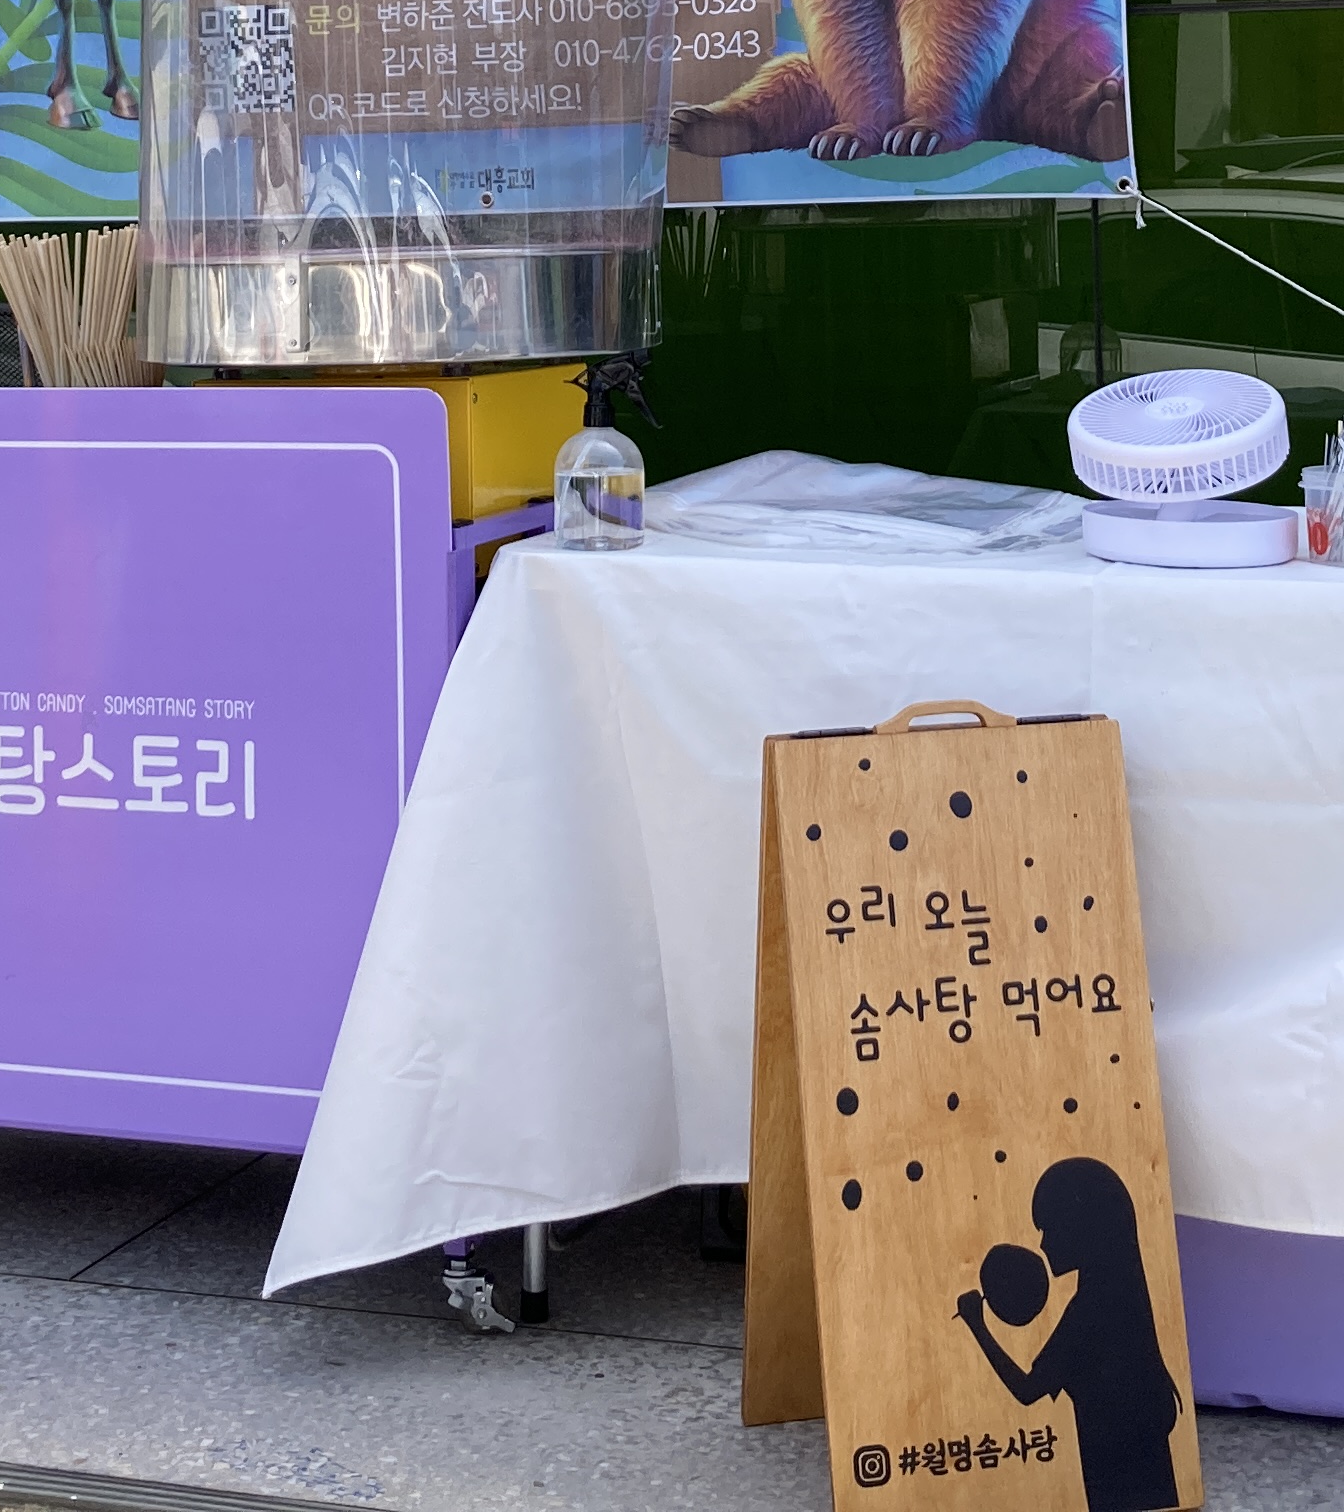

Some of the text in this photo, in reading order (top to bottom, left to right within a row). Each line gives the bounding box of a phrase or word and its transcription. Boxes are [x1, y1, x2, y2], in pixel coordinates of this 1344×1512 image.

[304, 3, 360, 36] 문의
[376, 0, 454, 33] 변하준
[381, 29, 761, 77] 김지현 부장 010-4762-0343
[308, 82, 583, 122] QR 코드로 신청하세요!
[478, 165, 534, 193] 대흥교회
[37, 693, 86, 713] CANDY
[104, 695, 197, 718] SOMSATANG
[204, 699, 255, 720] STORY
[824, 886, 992, 967] 우리 오늘
[849, 973, 1123, 1062] 솜사탕 먹어요
[899, 1425, 1058, 1476] #월명솜사탕
